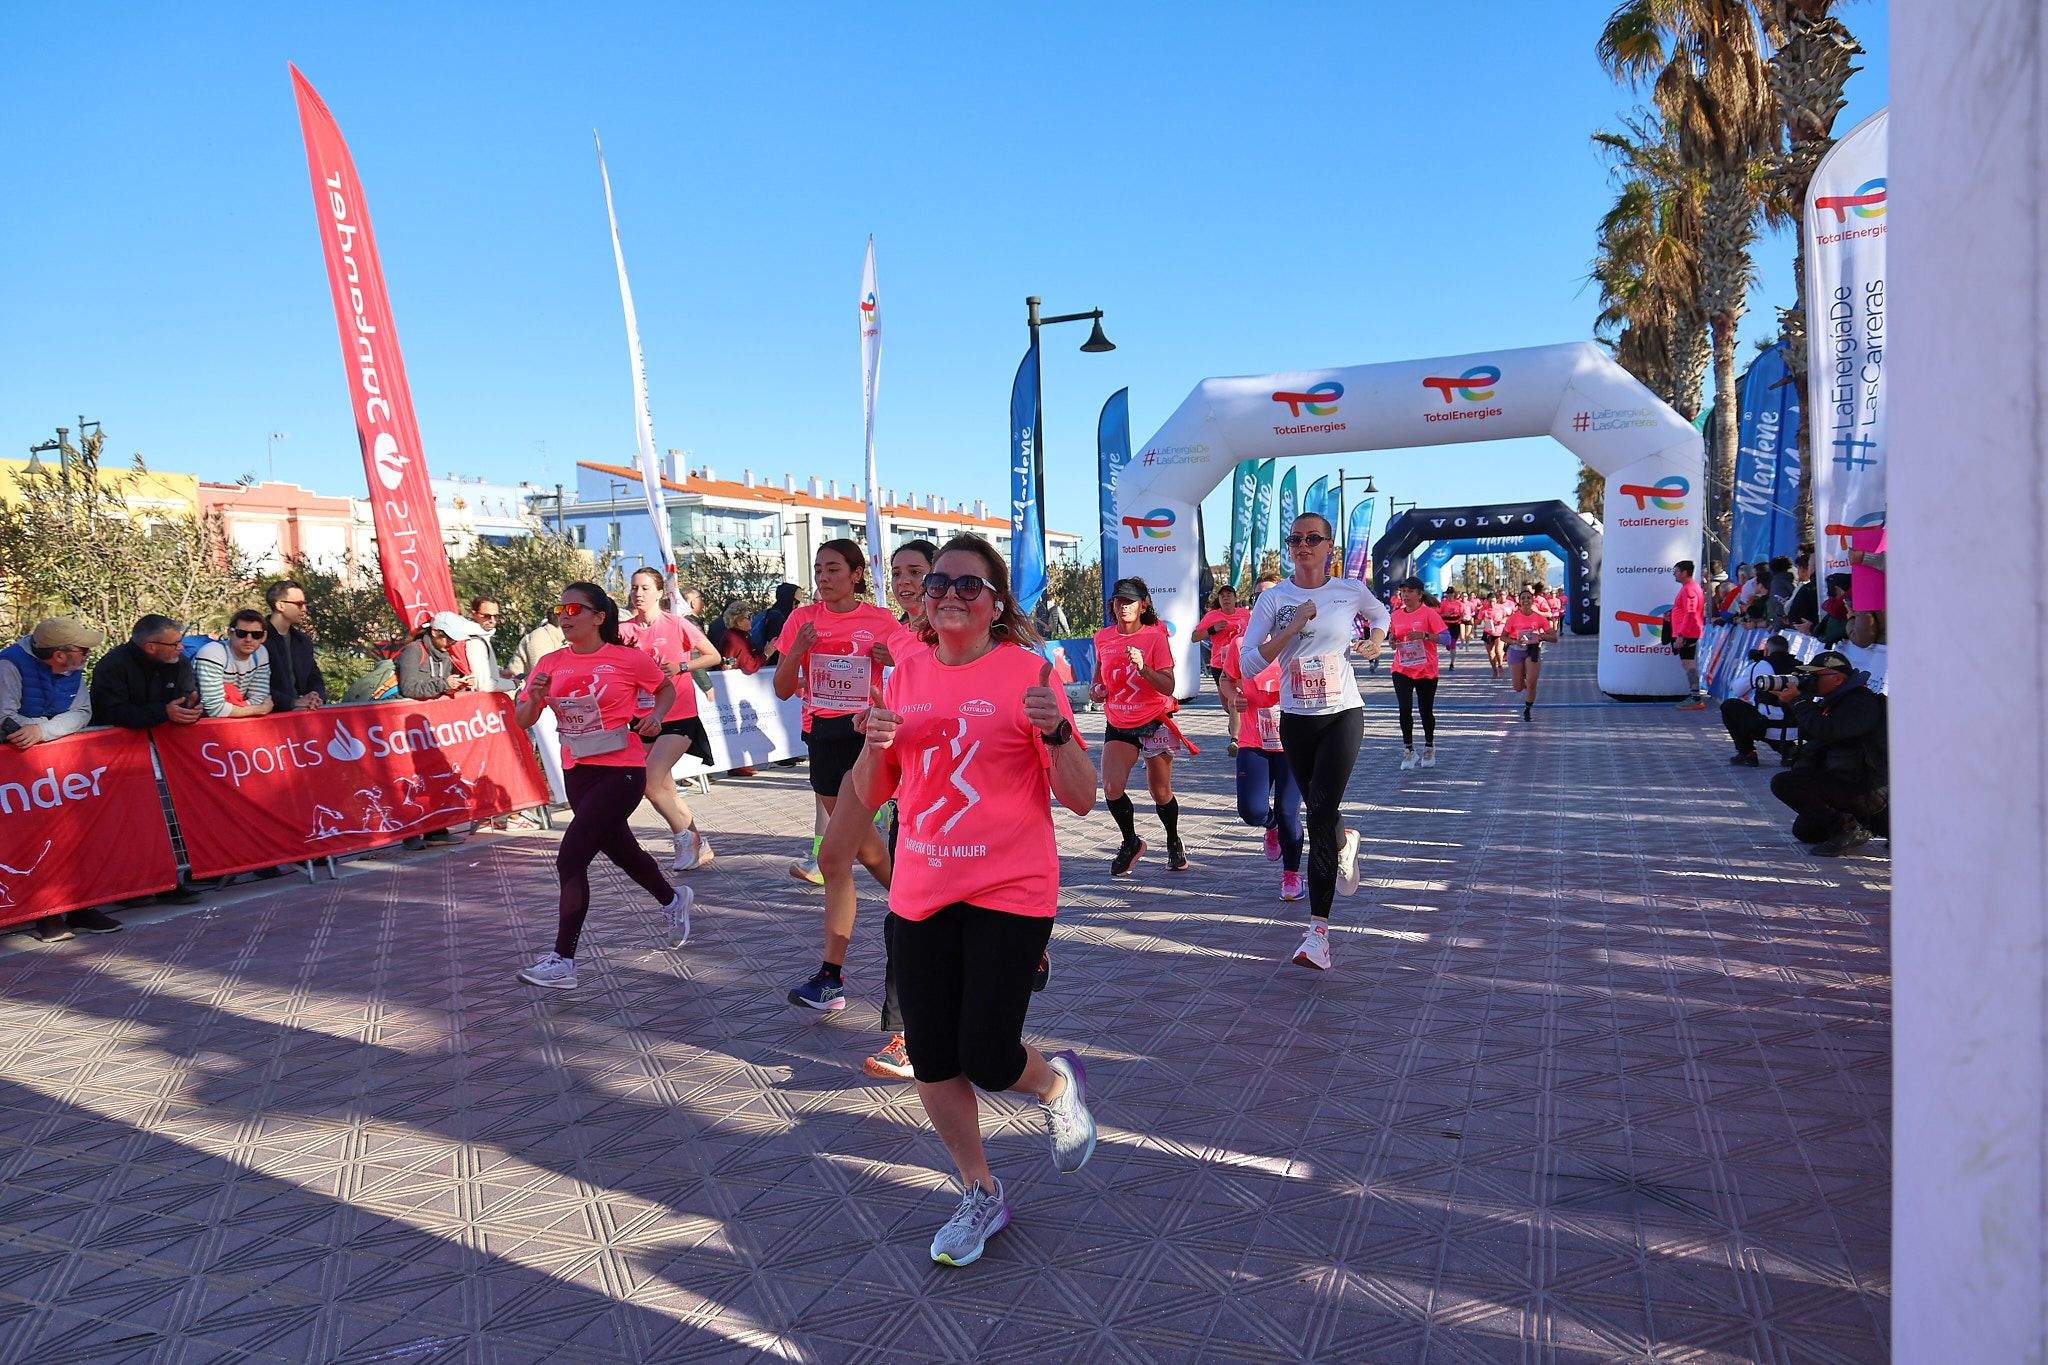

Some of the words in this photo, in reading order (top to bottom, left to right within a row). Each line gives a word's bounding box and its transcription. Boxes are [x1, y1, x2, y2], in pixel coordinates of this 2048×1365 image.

[1816, 223, 1888, 245] TotalEnergie
[1861, 279, 1884, 426] LasCarreras
[1424, 407, 1502, 422] TotalEnergies
[1273, 421, 1347, 435] TotalEnergies
[1736, 410, 1780, 516] Marlene
[1012, 426, 1036, 532] Marlene
[1233, 473, 1258, 567] Btiste
[1253, 484, 1273, 566] Btiste
[1430, 513, 1536, 528] VOLVO
[1619, 517, 1690, 528] TotalEnergies
[1281, 489, 1296, 573] Btiste
[1122, 544, 1177, 554] TotalEnergies
[1616, 565, 1676, 574] totalenergies
[1147, 584, 1177, 594] gies.es
[1383, 559, 1391, 611] OLVO
[1580, 552, 1590, 625] VOLVO
[1614, 644, 1672, 655] TotalEnerg
[829, 679, 852, 690] 016
[1306, 678, 1327, 688] 016
[901, 702, 932, 714] OYSHO
[566, 715, 584, 724] 016
[202, 737, 322, 787] Sports
[368, 708, 506, 758] Santander
[0, 766, 107, 814] nder
[927, 844, 936, 856] DE
[938, 845, 949, 857] LA
[952, 844, 986, 857] MUJER
